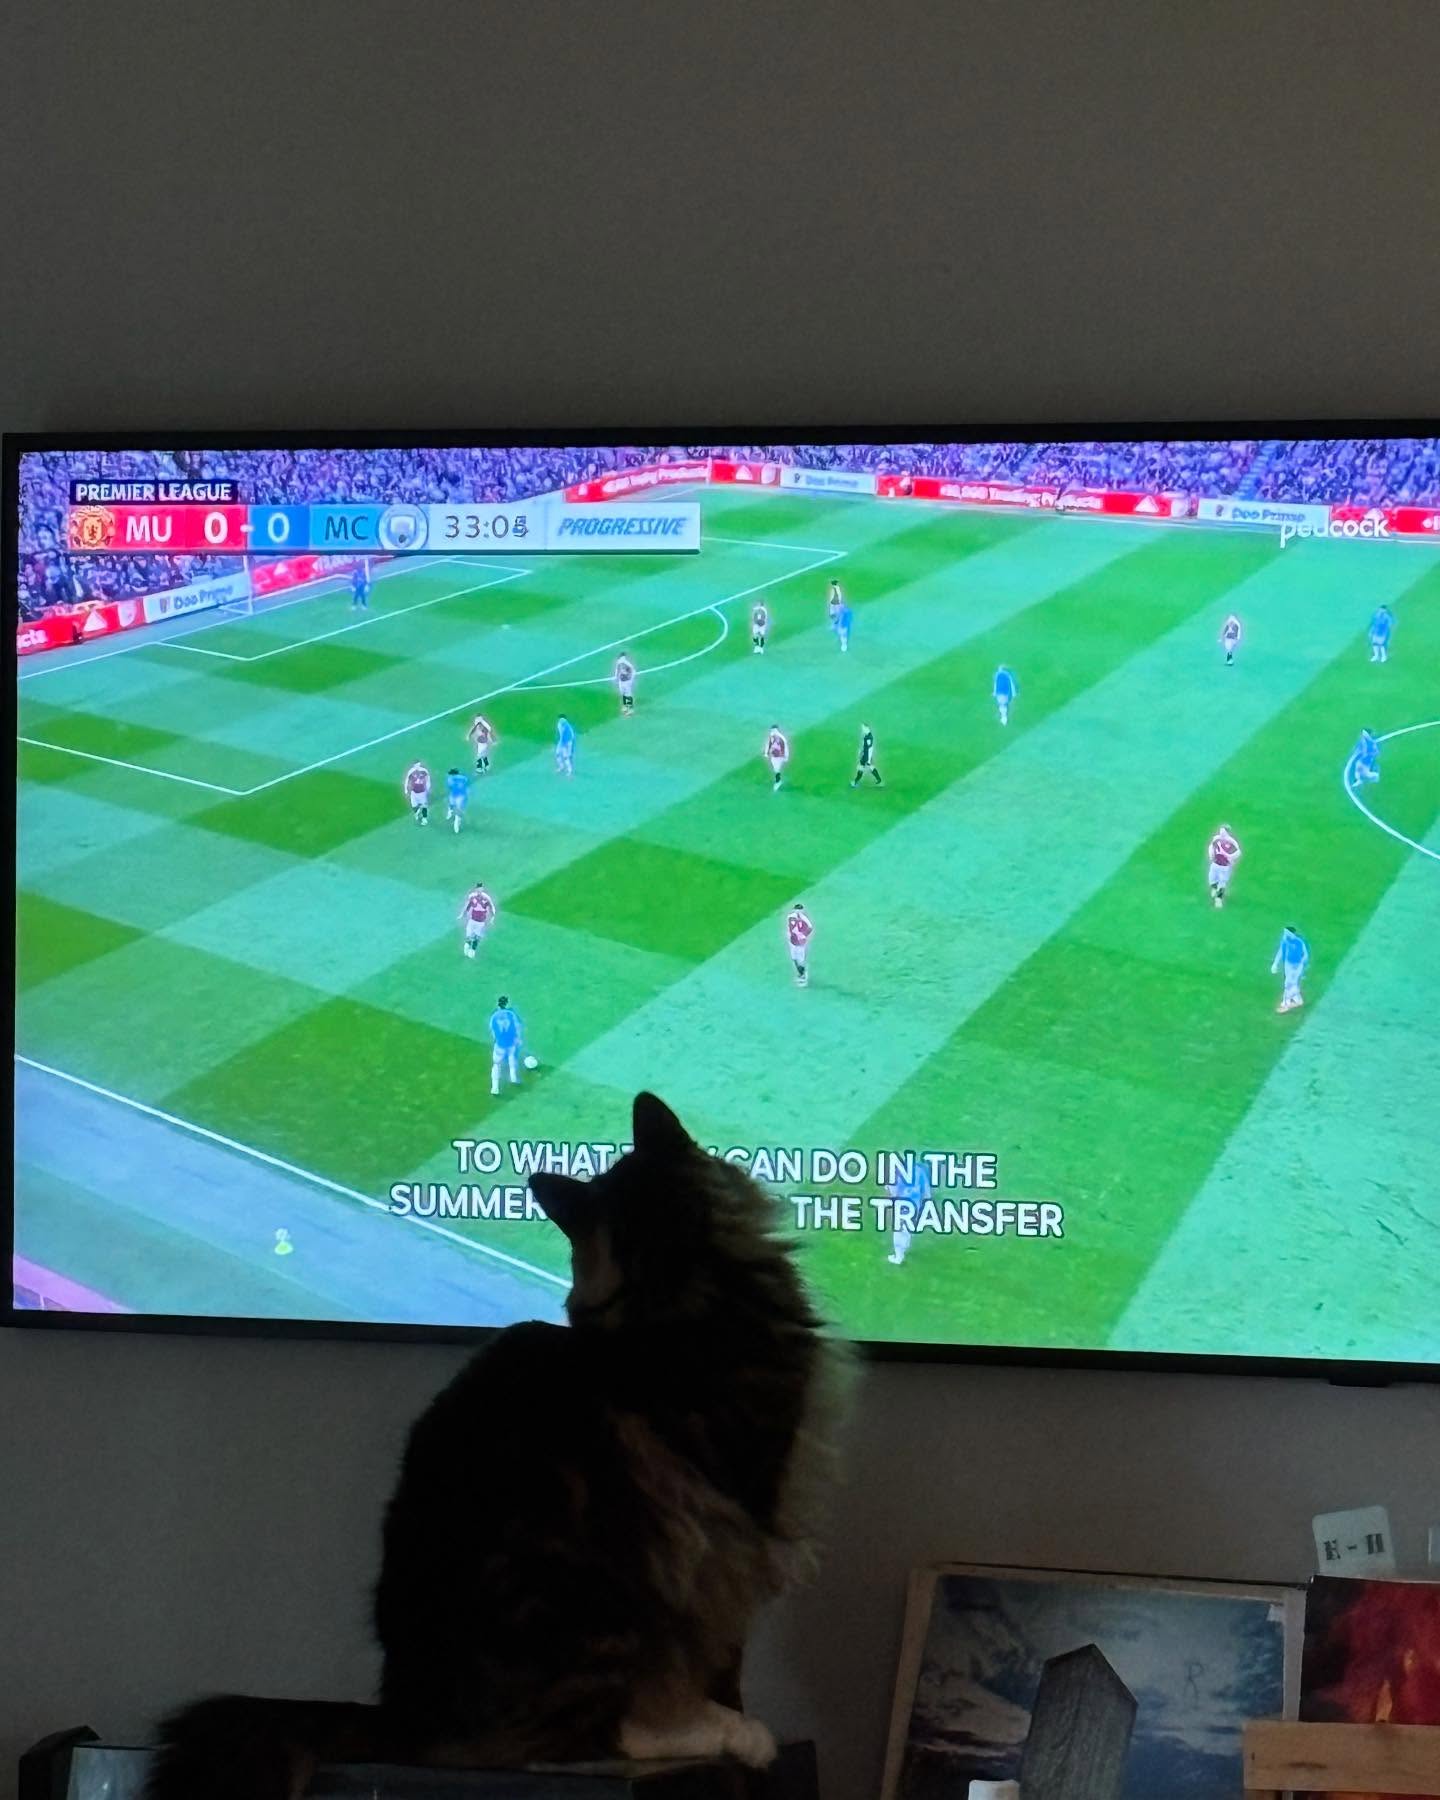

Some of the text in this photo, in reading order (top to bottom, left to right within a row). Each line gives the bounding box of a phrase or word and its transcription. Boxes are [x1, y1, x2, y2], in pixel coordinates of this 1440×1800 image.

[76, 483, 231, 501] PREMIER LEAGUE
[126, 515, 172, 543] MU
[203, 511, 229, 544] 0
[267, 511, 290, 543] 0
[325, 515, 369, 541] MC
[557, 517, 687, 537] PROGRESSIVE
[453, 1140, 614, 1177] TO WHAT
[812, 1149, 868, 1183] DO
[877, 1152, 914, 1184] IN
[923, 1153, 997, 1188] THE
[790, 1196, 1064, 1237] THE TRANSFER
